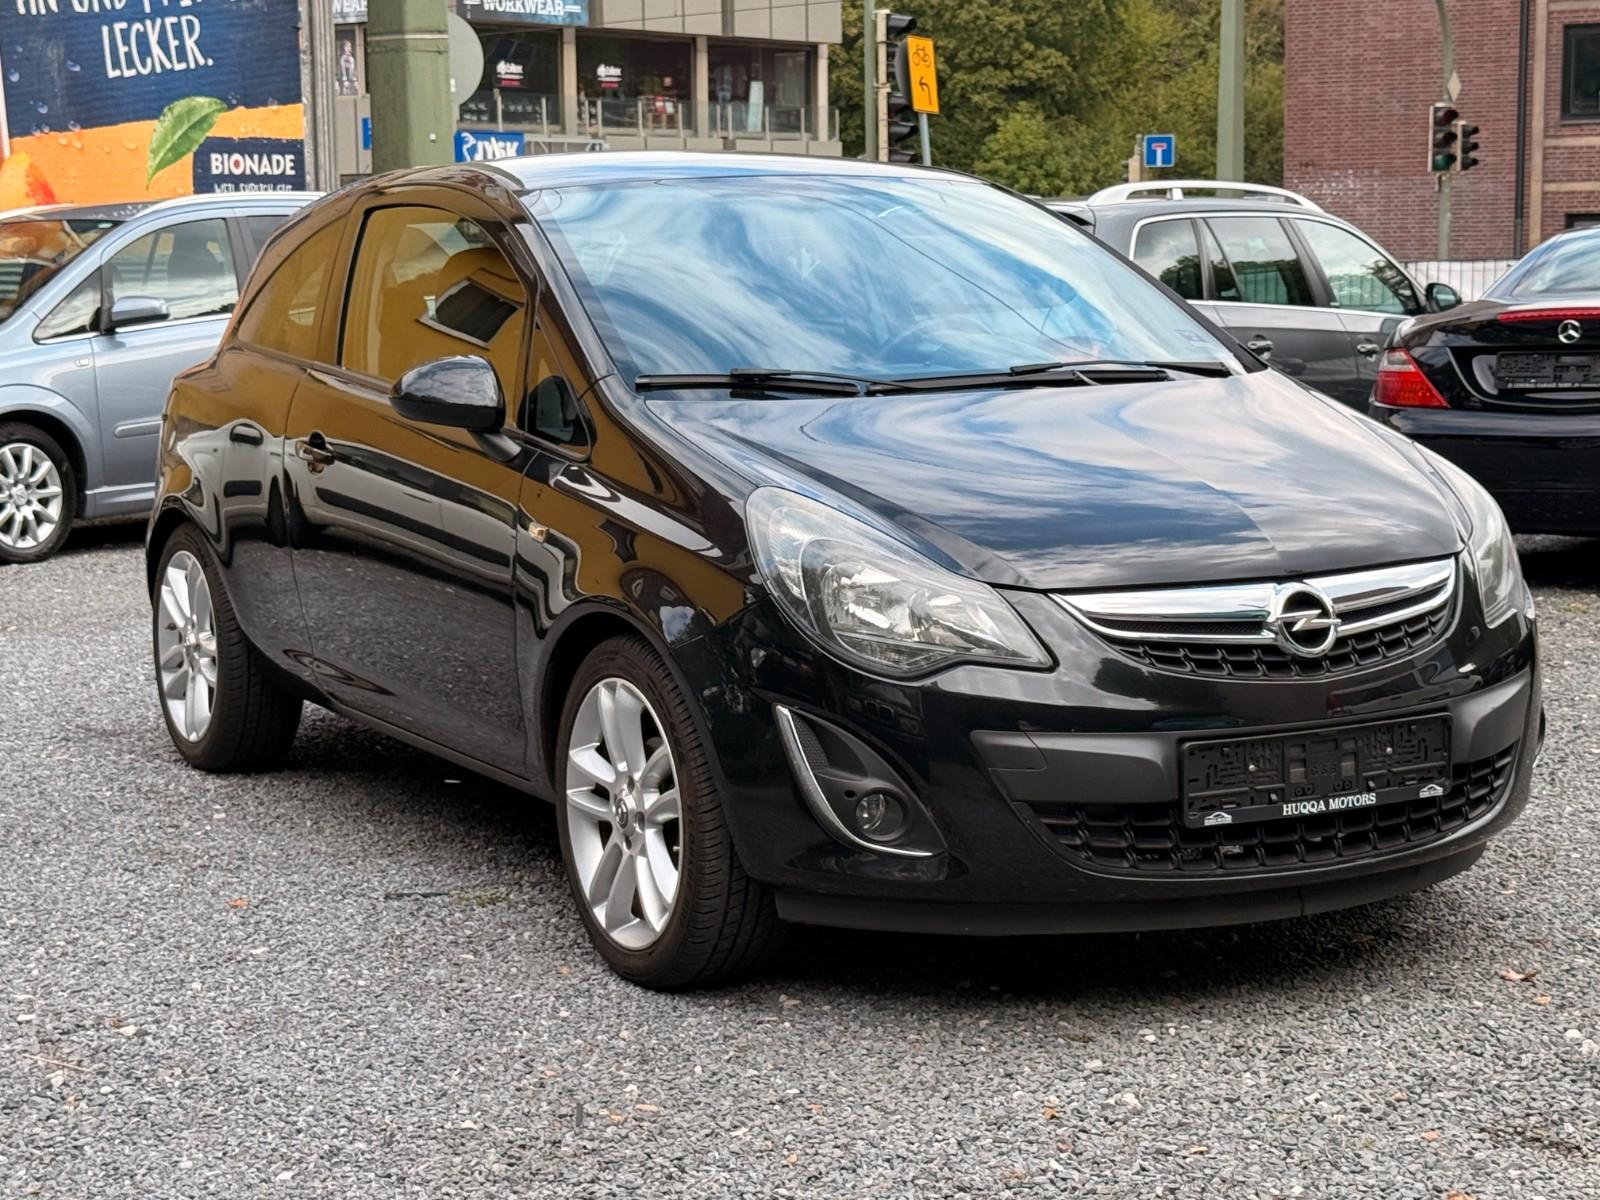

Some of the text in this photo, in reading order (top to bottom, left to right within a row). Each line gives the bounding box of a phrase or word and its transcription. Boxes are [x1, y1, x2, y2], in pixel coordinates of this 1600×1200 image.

[482, 0, 565, 16] WORKWEAR
[102, 15, 213, 79] LECKER.
[474, 136, 519, 161] JYSK
[210, 153, 296, 175] BIONADE
[1282, 792, 1377, 815] HUQQA MOTORS
